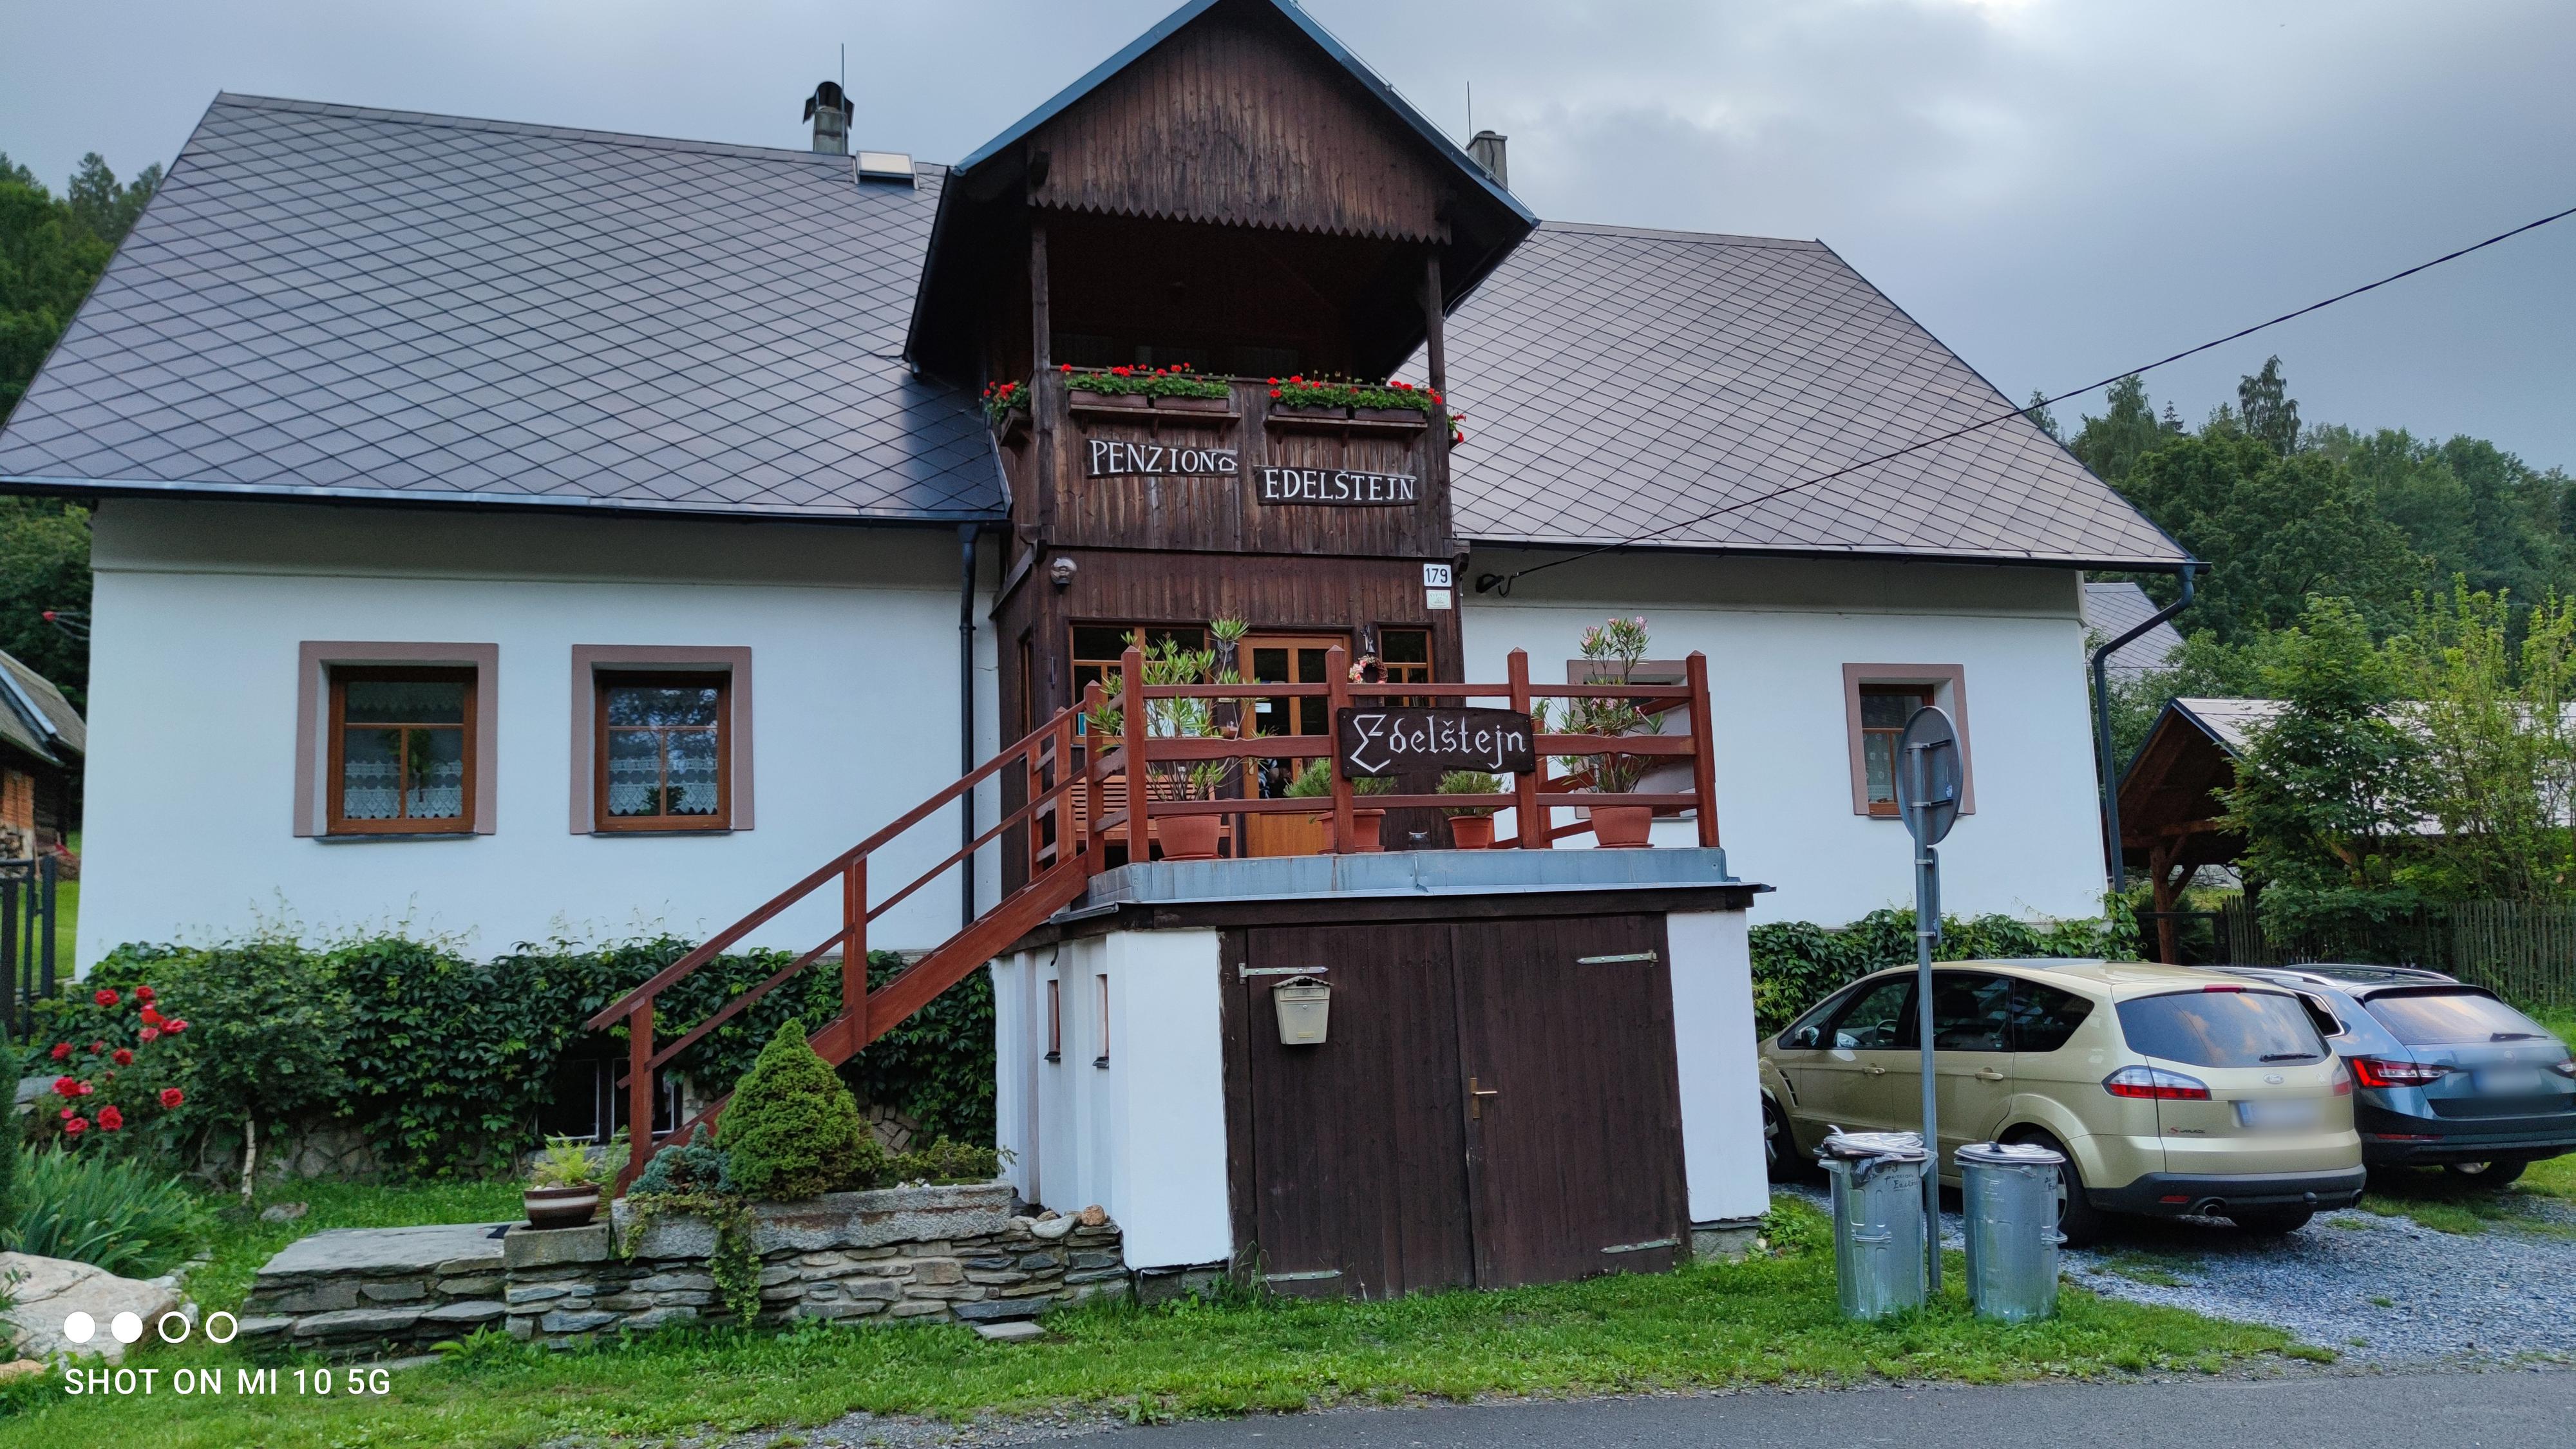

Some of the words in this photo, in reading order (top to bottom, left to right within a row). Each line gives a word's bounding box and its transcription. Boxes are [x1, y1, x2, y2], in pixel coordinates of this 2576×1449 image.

[1089, 440, 1217, 475] PENZION
[1264, 469, 1416, 500] EDELŠTEJN
[1425, 567, 1448, 583] 179
[1349, 714, 1527, 773] Edelštejn
